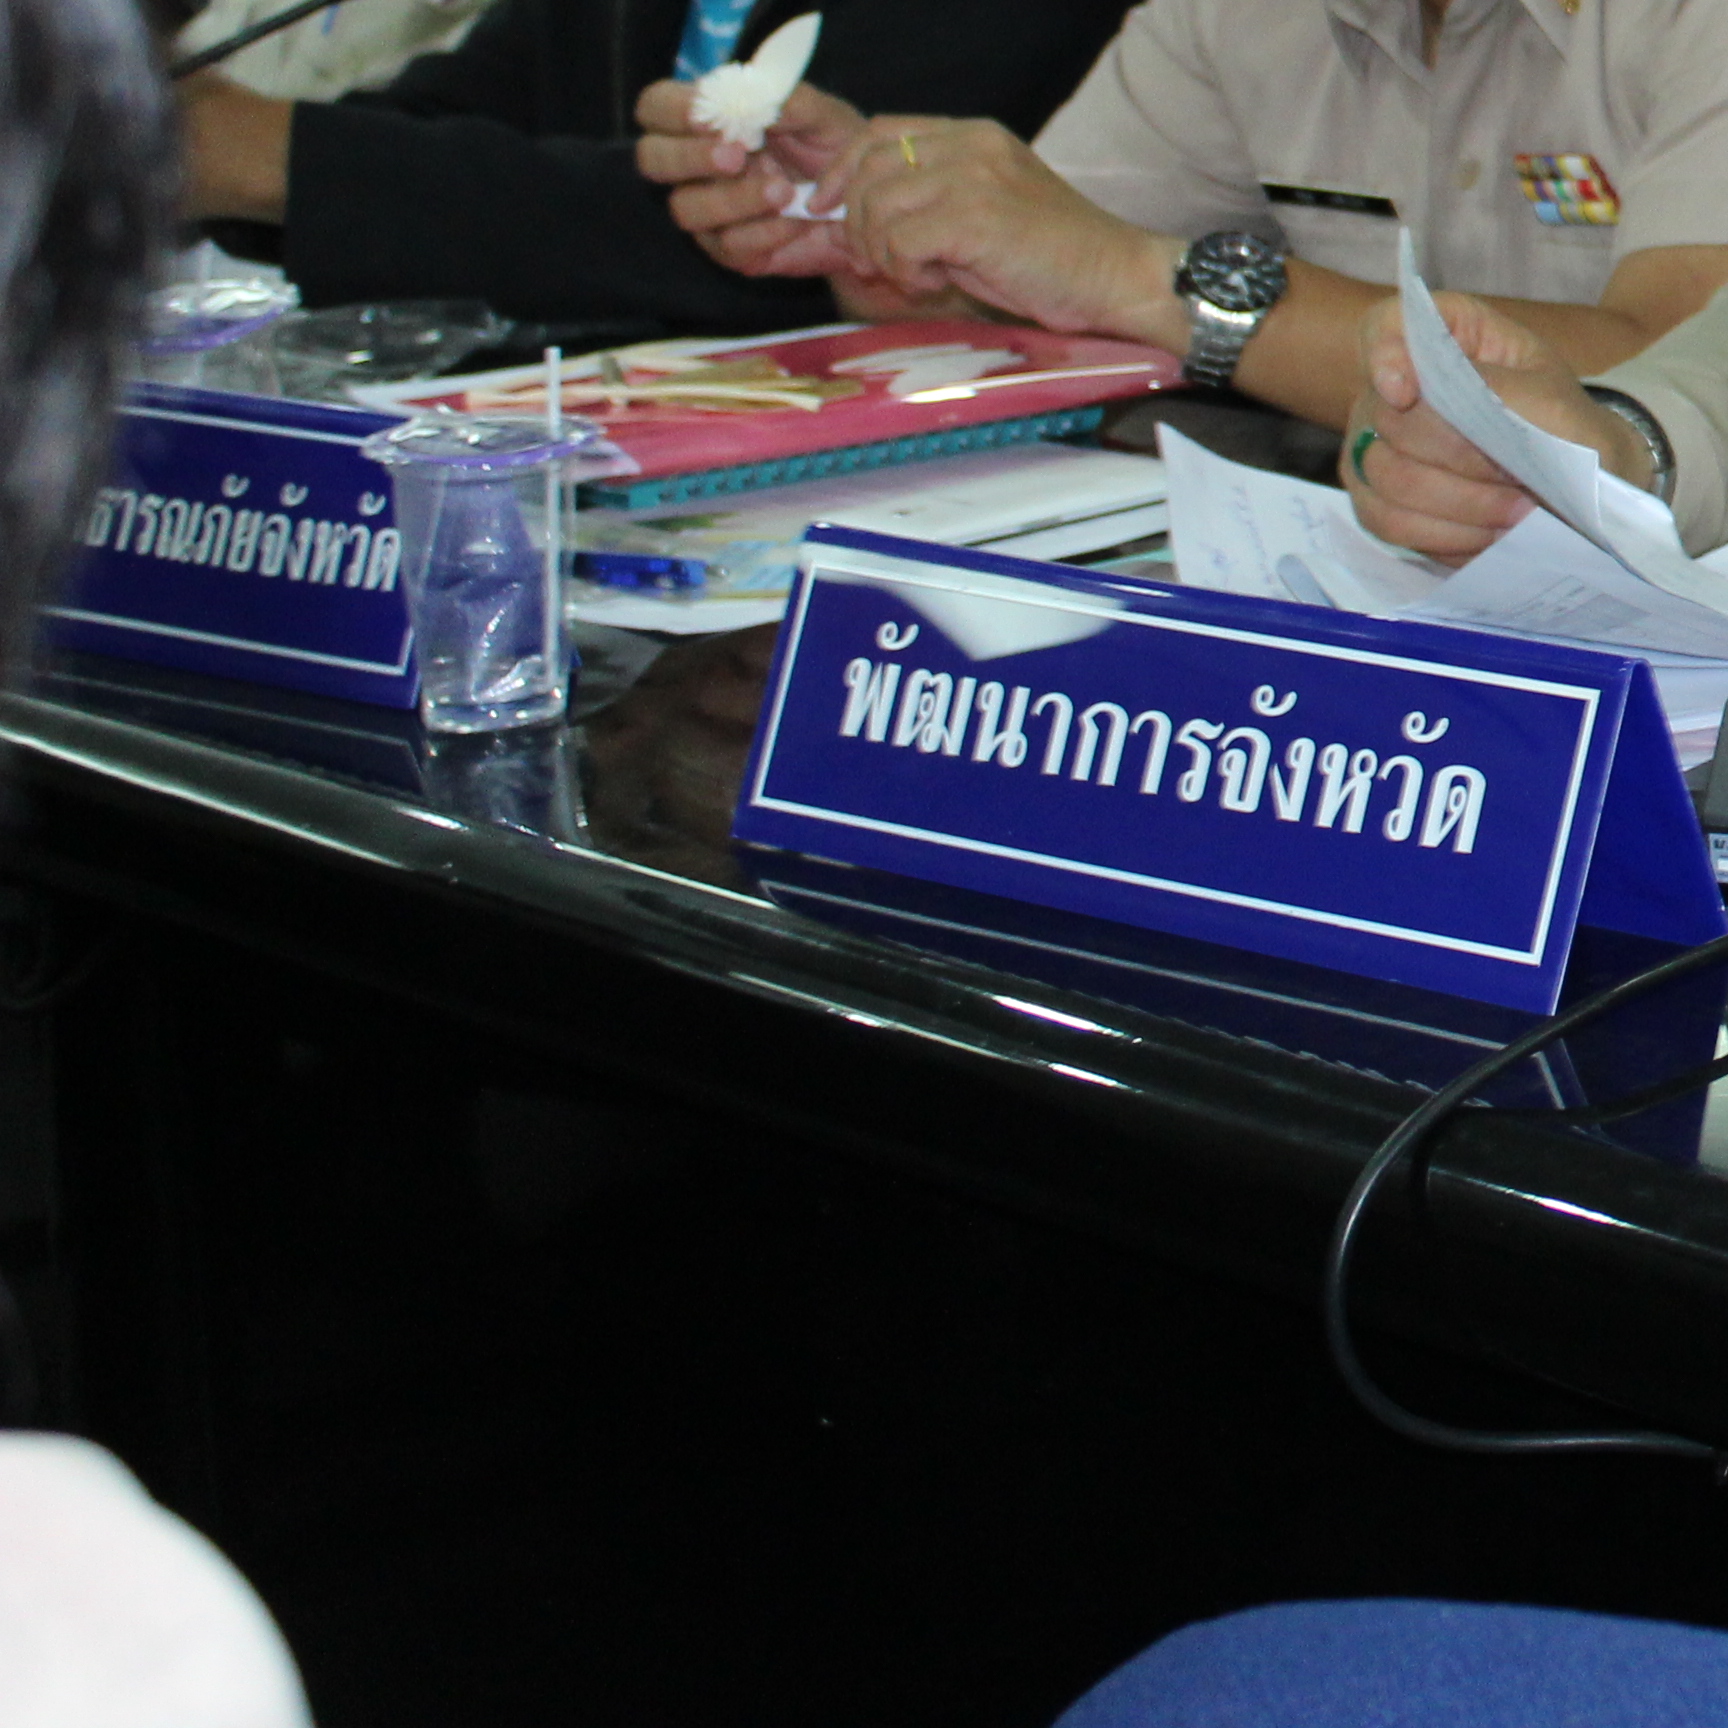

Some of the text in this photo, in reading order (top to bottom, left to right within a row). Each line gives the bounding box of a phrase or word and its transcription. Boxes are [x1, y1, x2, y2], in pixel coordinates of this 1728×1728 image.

[82, 474, 401, 593] ธารณภัยจังหวัด
[838, 621, 1488, 855] พัฒนาการจังหวัด
